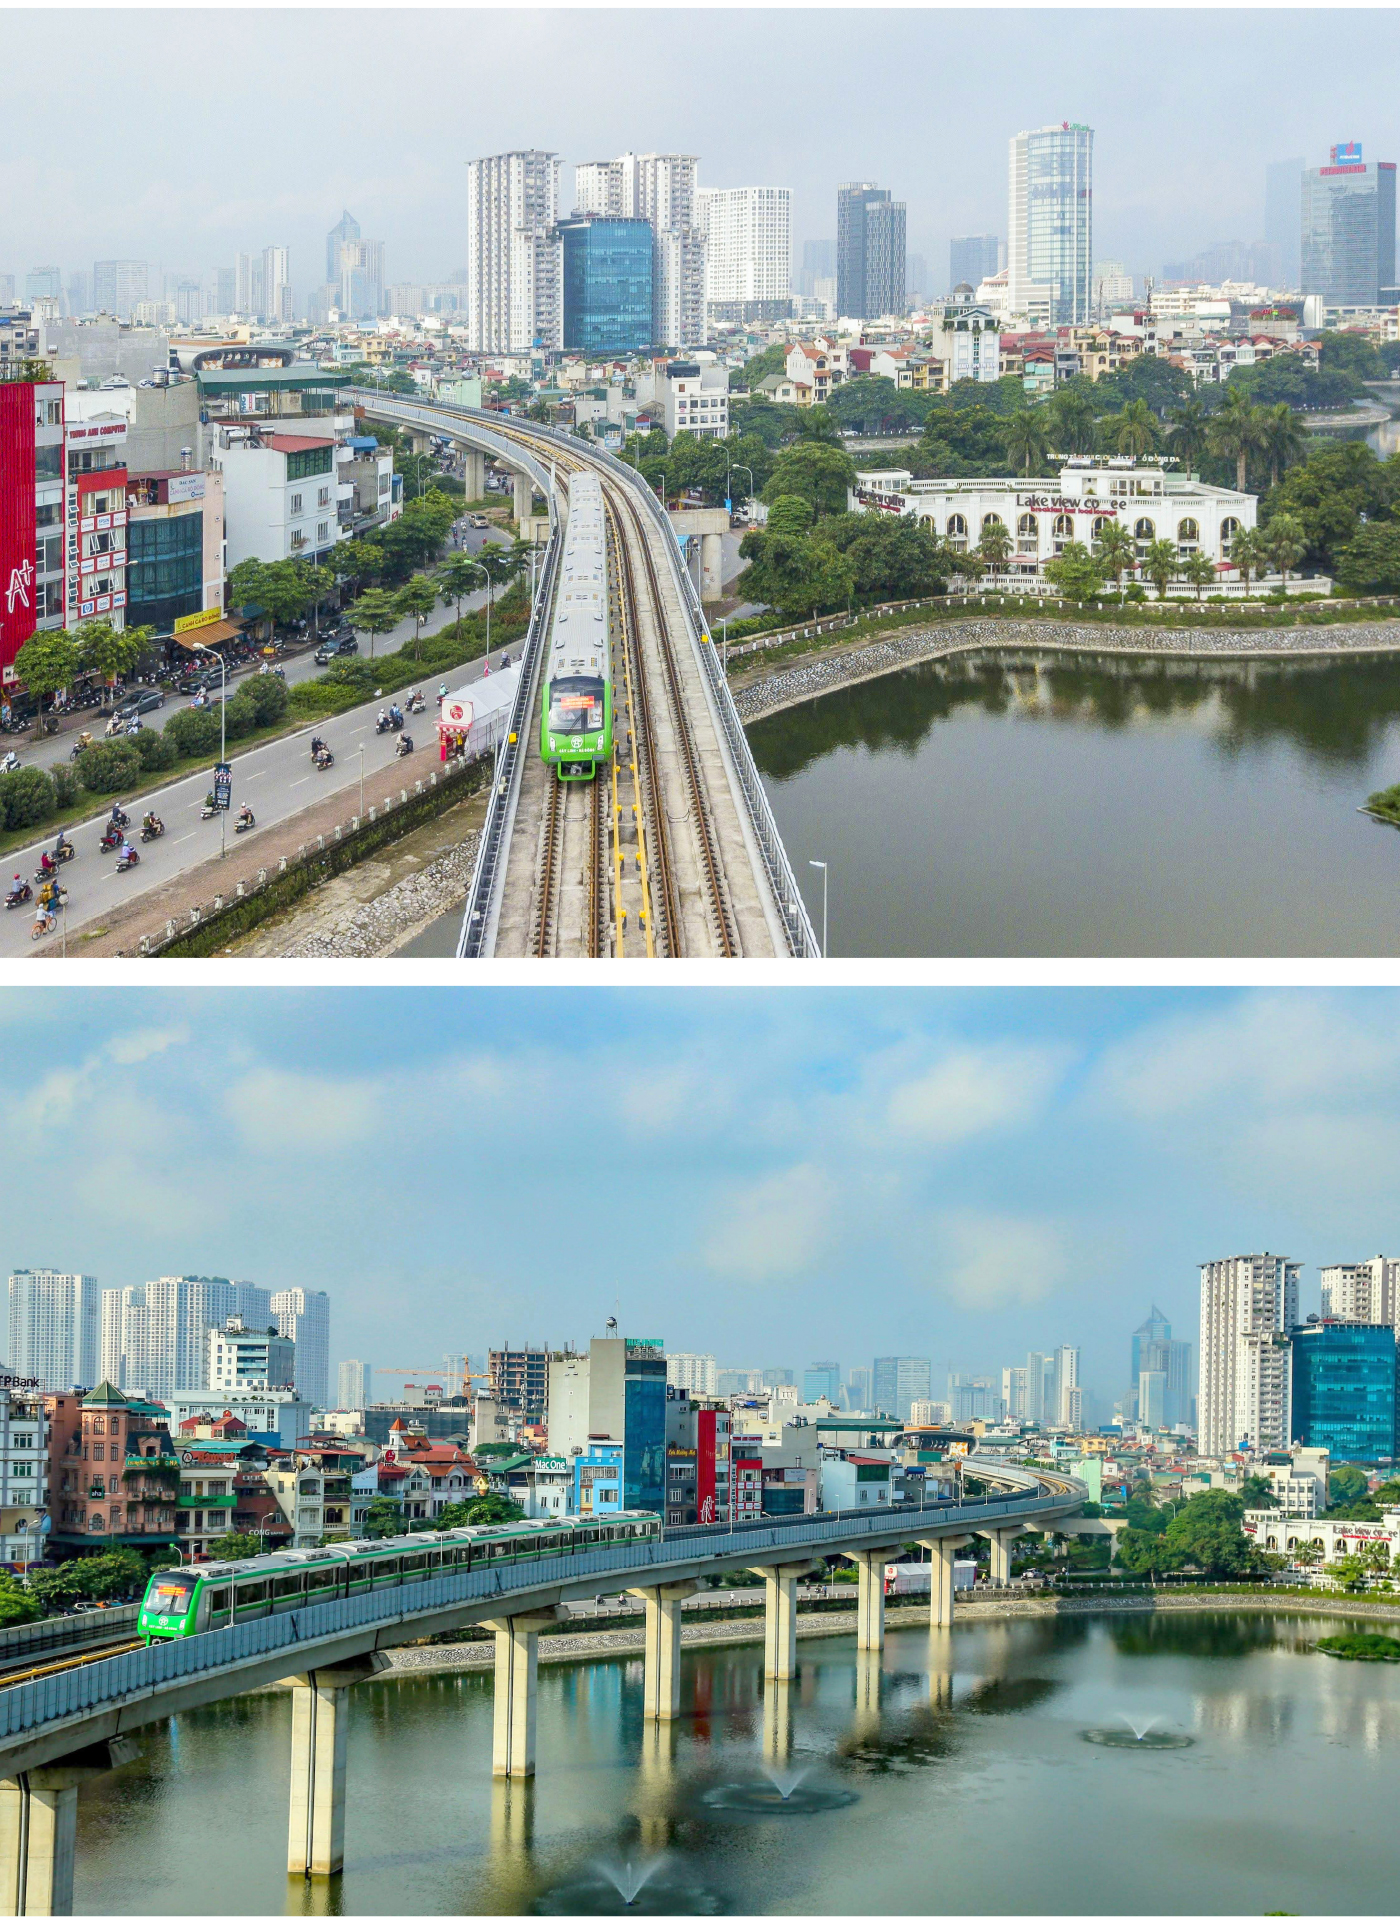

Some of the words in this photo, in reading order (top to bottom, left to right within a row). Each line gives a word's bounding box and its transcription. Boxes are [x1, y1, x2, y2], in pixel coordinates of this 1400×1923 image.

[88, 428, 99, 436] ANH
[100, 424, 126, 435] COMPUTER
[1047, 452, 1068, 460] TRUNG
[1016, 494, 1048, 507] Lake
[1051, 496, 1080, 508] view
[535, 1459, 549, 1469] Mac
[550, 1460, 565, 1469] One
[1333, 1524, 1353, 1534] Lake
